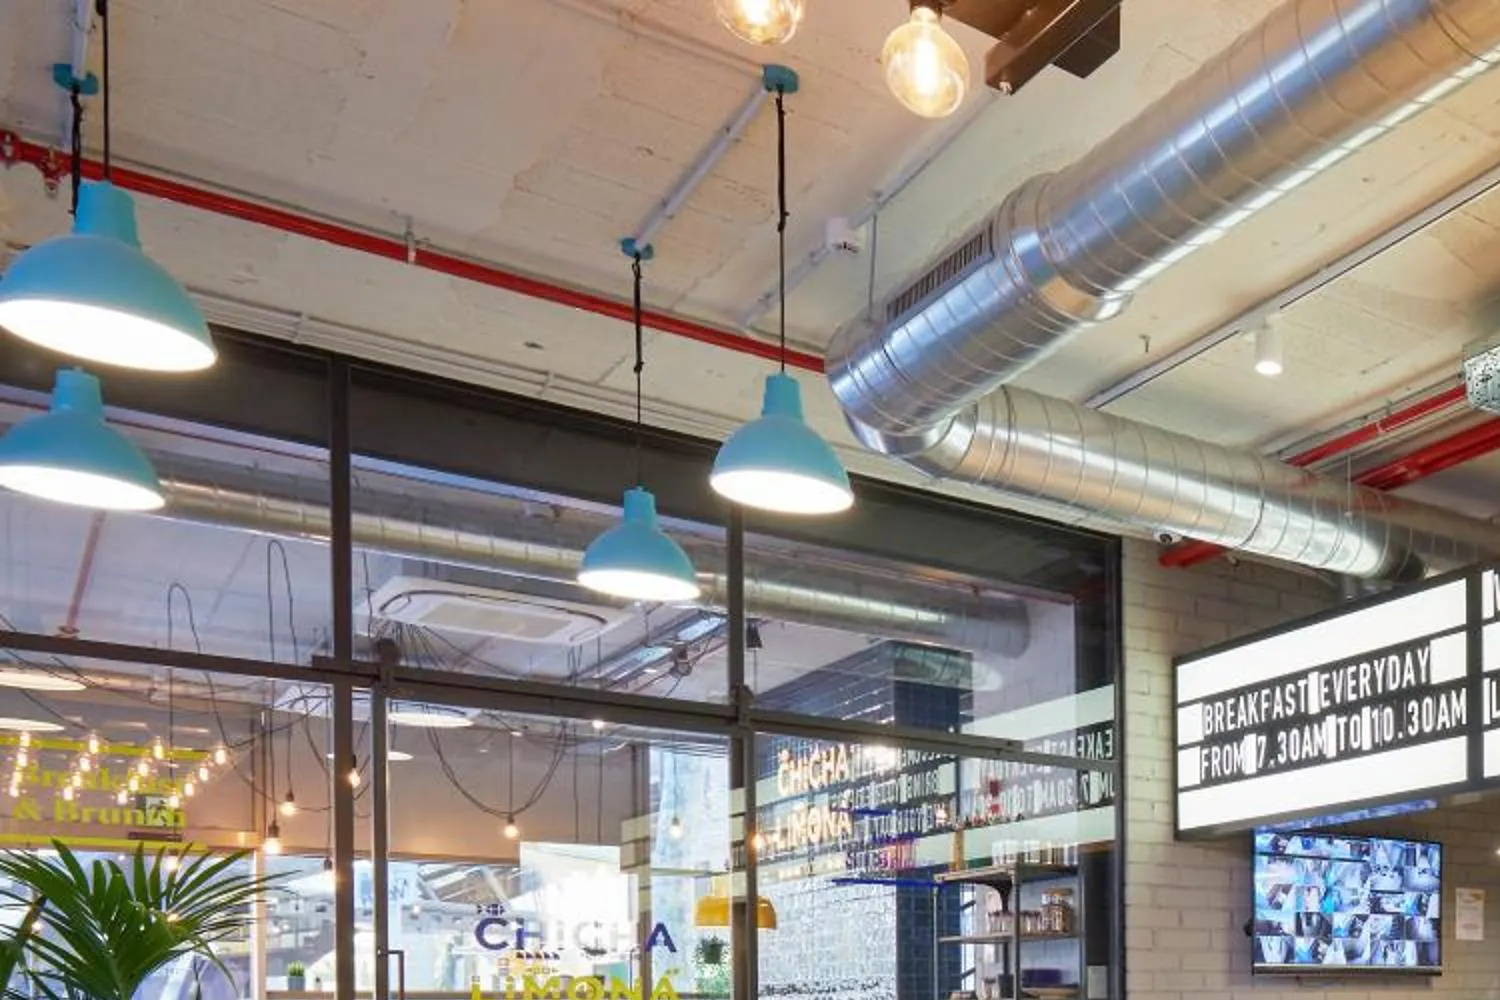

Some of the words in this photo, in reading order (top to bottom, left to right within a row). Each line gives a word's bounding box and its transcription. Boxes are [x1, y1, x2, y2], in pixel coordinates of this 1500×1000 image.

[1200, 740, 1245, 781] FROM
[1256, 720, 1327, 770] 7.30AM
[1338, 713, 1363, 752] TO
[1370, 687, 1468, 745] 10.30AM
[1204, 678, 1309, 735] BREAKFAST
[1320, 645, 1431, 709] EVERYDAY
